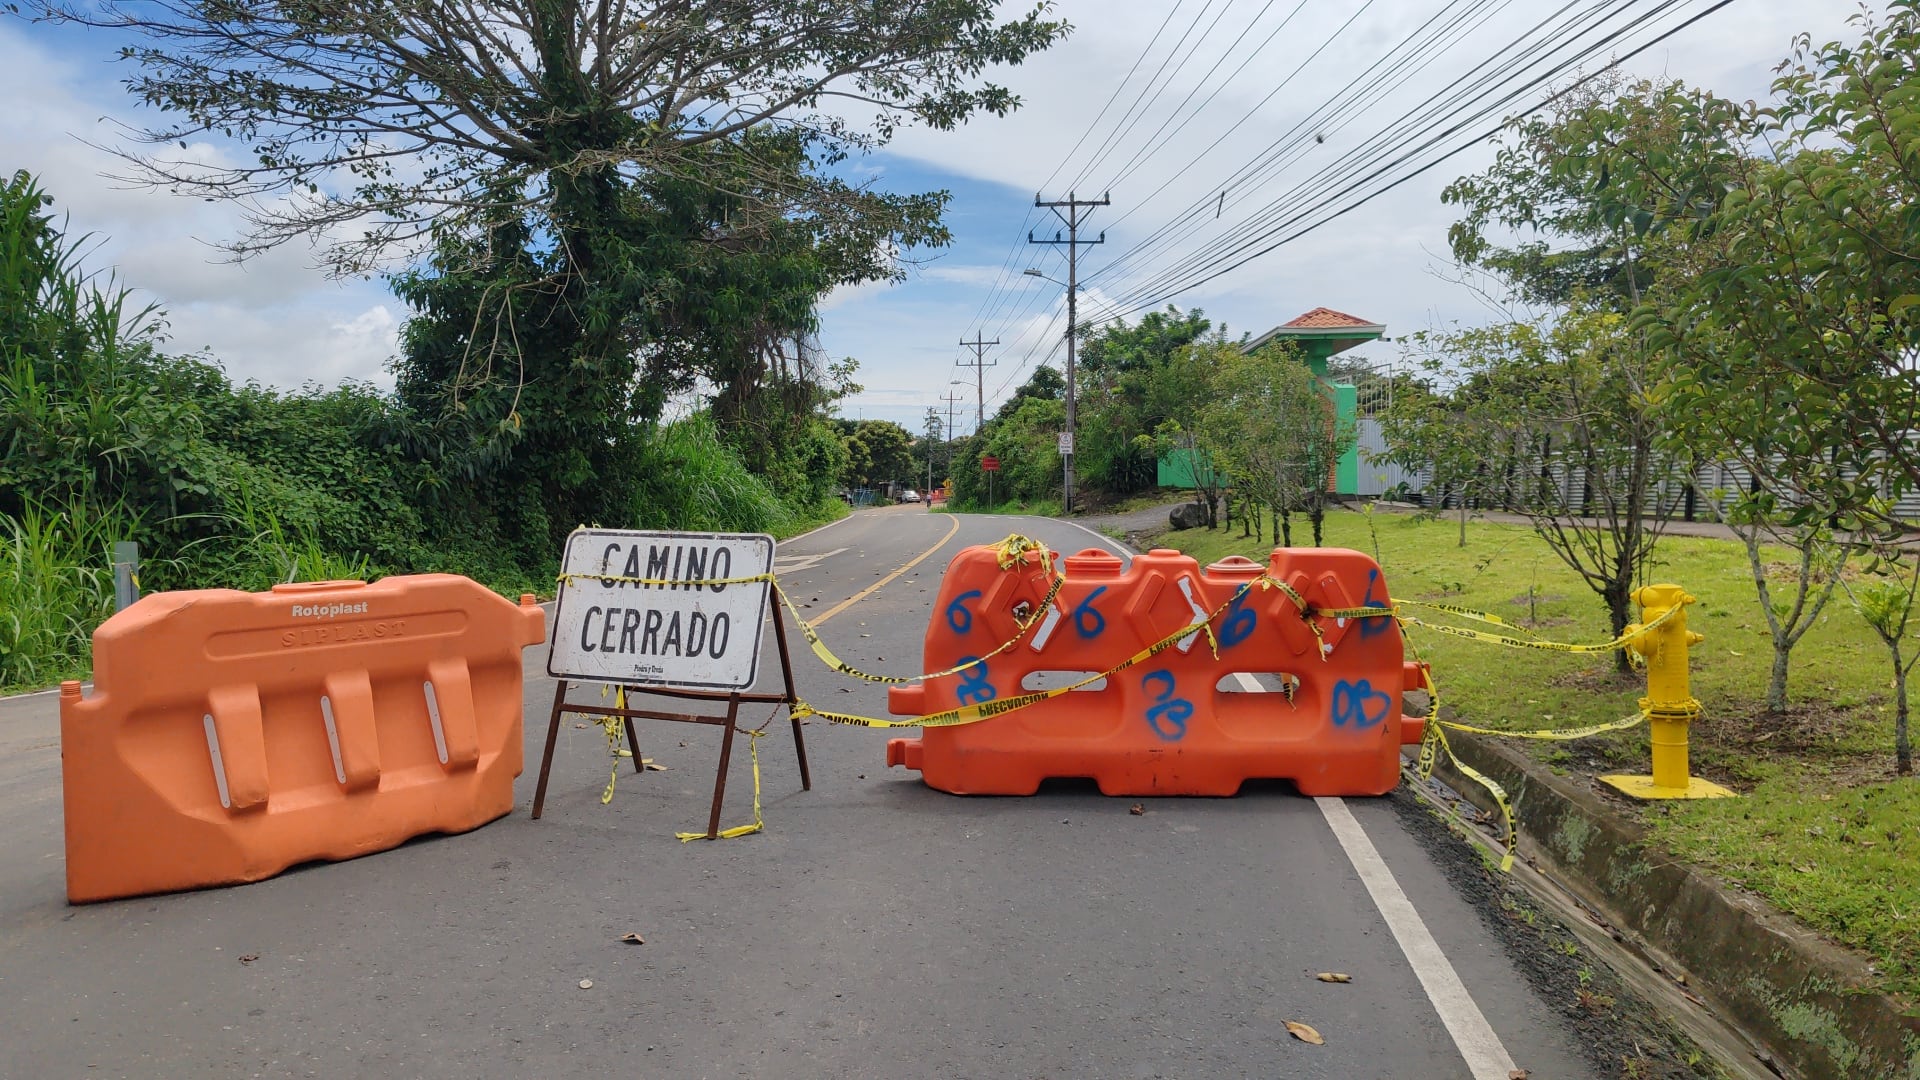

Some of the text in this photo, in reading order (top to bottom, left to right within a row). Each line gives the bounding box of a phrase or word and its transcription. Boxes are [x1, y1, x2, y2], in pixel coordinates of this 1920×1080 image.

[600, 543, 731, 593] CAMINO
[281, 620, 406, 648] SIPLAST
[292, 602, 368, 617] Rotoplast
[581, 606, 730, 659] CERRADO
[946, 589, 982, 635] 6
[1074, 585, 1108, 639] 6
[1220, 582, 1257, 650] 6
